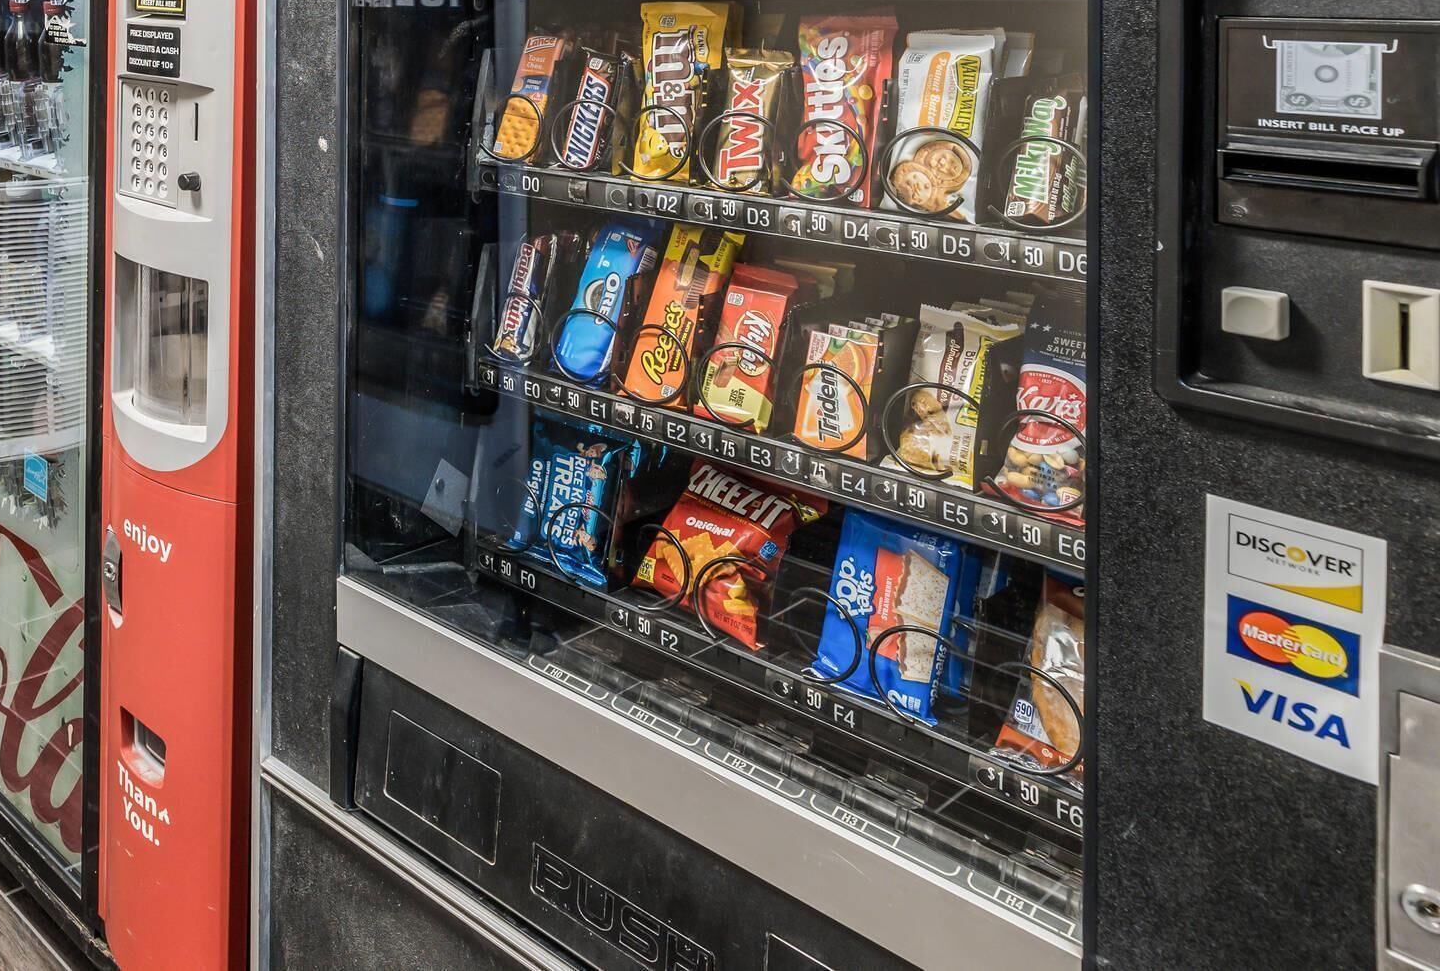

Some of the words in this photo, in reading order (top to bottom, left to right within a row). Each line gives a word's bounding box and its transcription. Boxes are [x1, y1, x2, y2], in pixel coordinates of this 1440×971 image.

[155, 0, 164, 7] BILL
[142, 30, 174, 40] DISPLAYED
[527, 37, 556, 48] Lance
[695, 29, 706, 57] PEANUT
[161, 47, 179, 55] CASH
[152, 60, 160, 68] OF
[933, 58, 947, 92] Peanut
[960, 59, 978, 99] NATURE
[928, 95, 940, 126] Butter
[952, 99, 974, 135] VALLEY
[564, 75, 608, 168] SNICKERS
[718, 80, 763, 181] TWIX
[1258, 118, 1305, 130] INSERT
[1308, 122, 1337, 132] BILL
[1341, 124, 1378, 136] FACE
[1382, 127, 1405, 137] UP
[522, 175, 540, 191] D0
[657, 196, 677, 212] D2
[747, 208, 770, 226] D3
[844, 222, 869, 241] D4
[943, 236, 971, 256] D5
[1059, 253, 1087, 274] D6
[1046, 344, 1077, 359] SALTY
[1053, 336, 1086, 350] SWEET
[943, 339, 960, 373] Almond
[524, 384, 540, 398] E0
[591, 401, 606, 418] E1
[667, 423, 686, 441] E2
[751, 445, 771, 466] E3
[574, 456, 587, 487] RICE
[841, 473, 866, 495] E4
[687, 464, 792, 529] CHEEZ-IT
[943, 503, 968, 525] E5
[123, 518, 172, 563] enjoy
[1059, 533, 1086, 558] E6
[1235, 531, 1357, 578] DISCOVER
[1266, 556, 1321, 576] NETWORK
[521, 571, 536, 589] F0
[882, 577, 892, 621] STRAWBERRY
[661, 631, 679, 652] F2
[1241, 622, 1344, 668] MasterCard
[635, 710, 652, 723] H1
[834, 703, 856, 729] F4
[1015, 701, 1032, 717] 590
[1233, 677, 1352, 750] VISA
[730, 756, 747, 770] H2
[123, 796, 160, 847] You.
[841, 812, 857, 826] H3
[1056, 799, 1083, 828] F6
[532, 842, 715, 971] PUSH
[1005, 895, 1025, 910] H4
